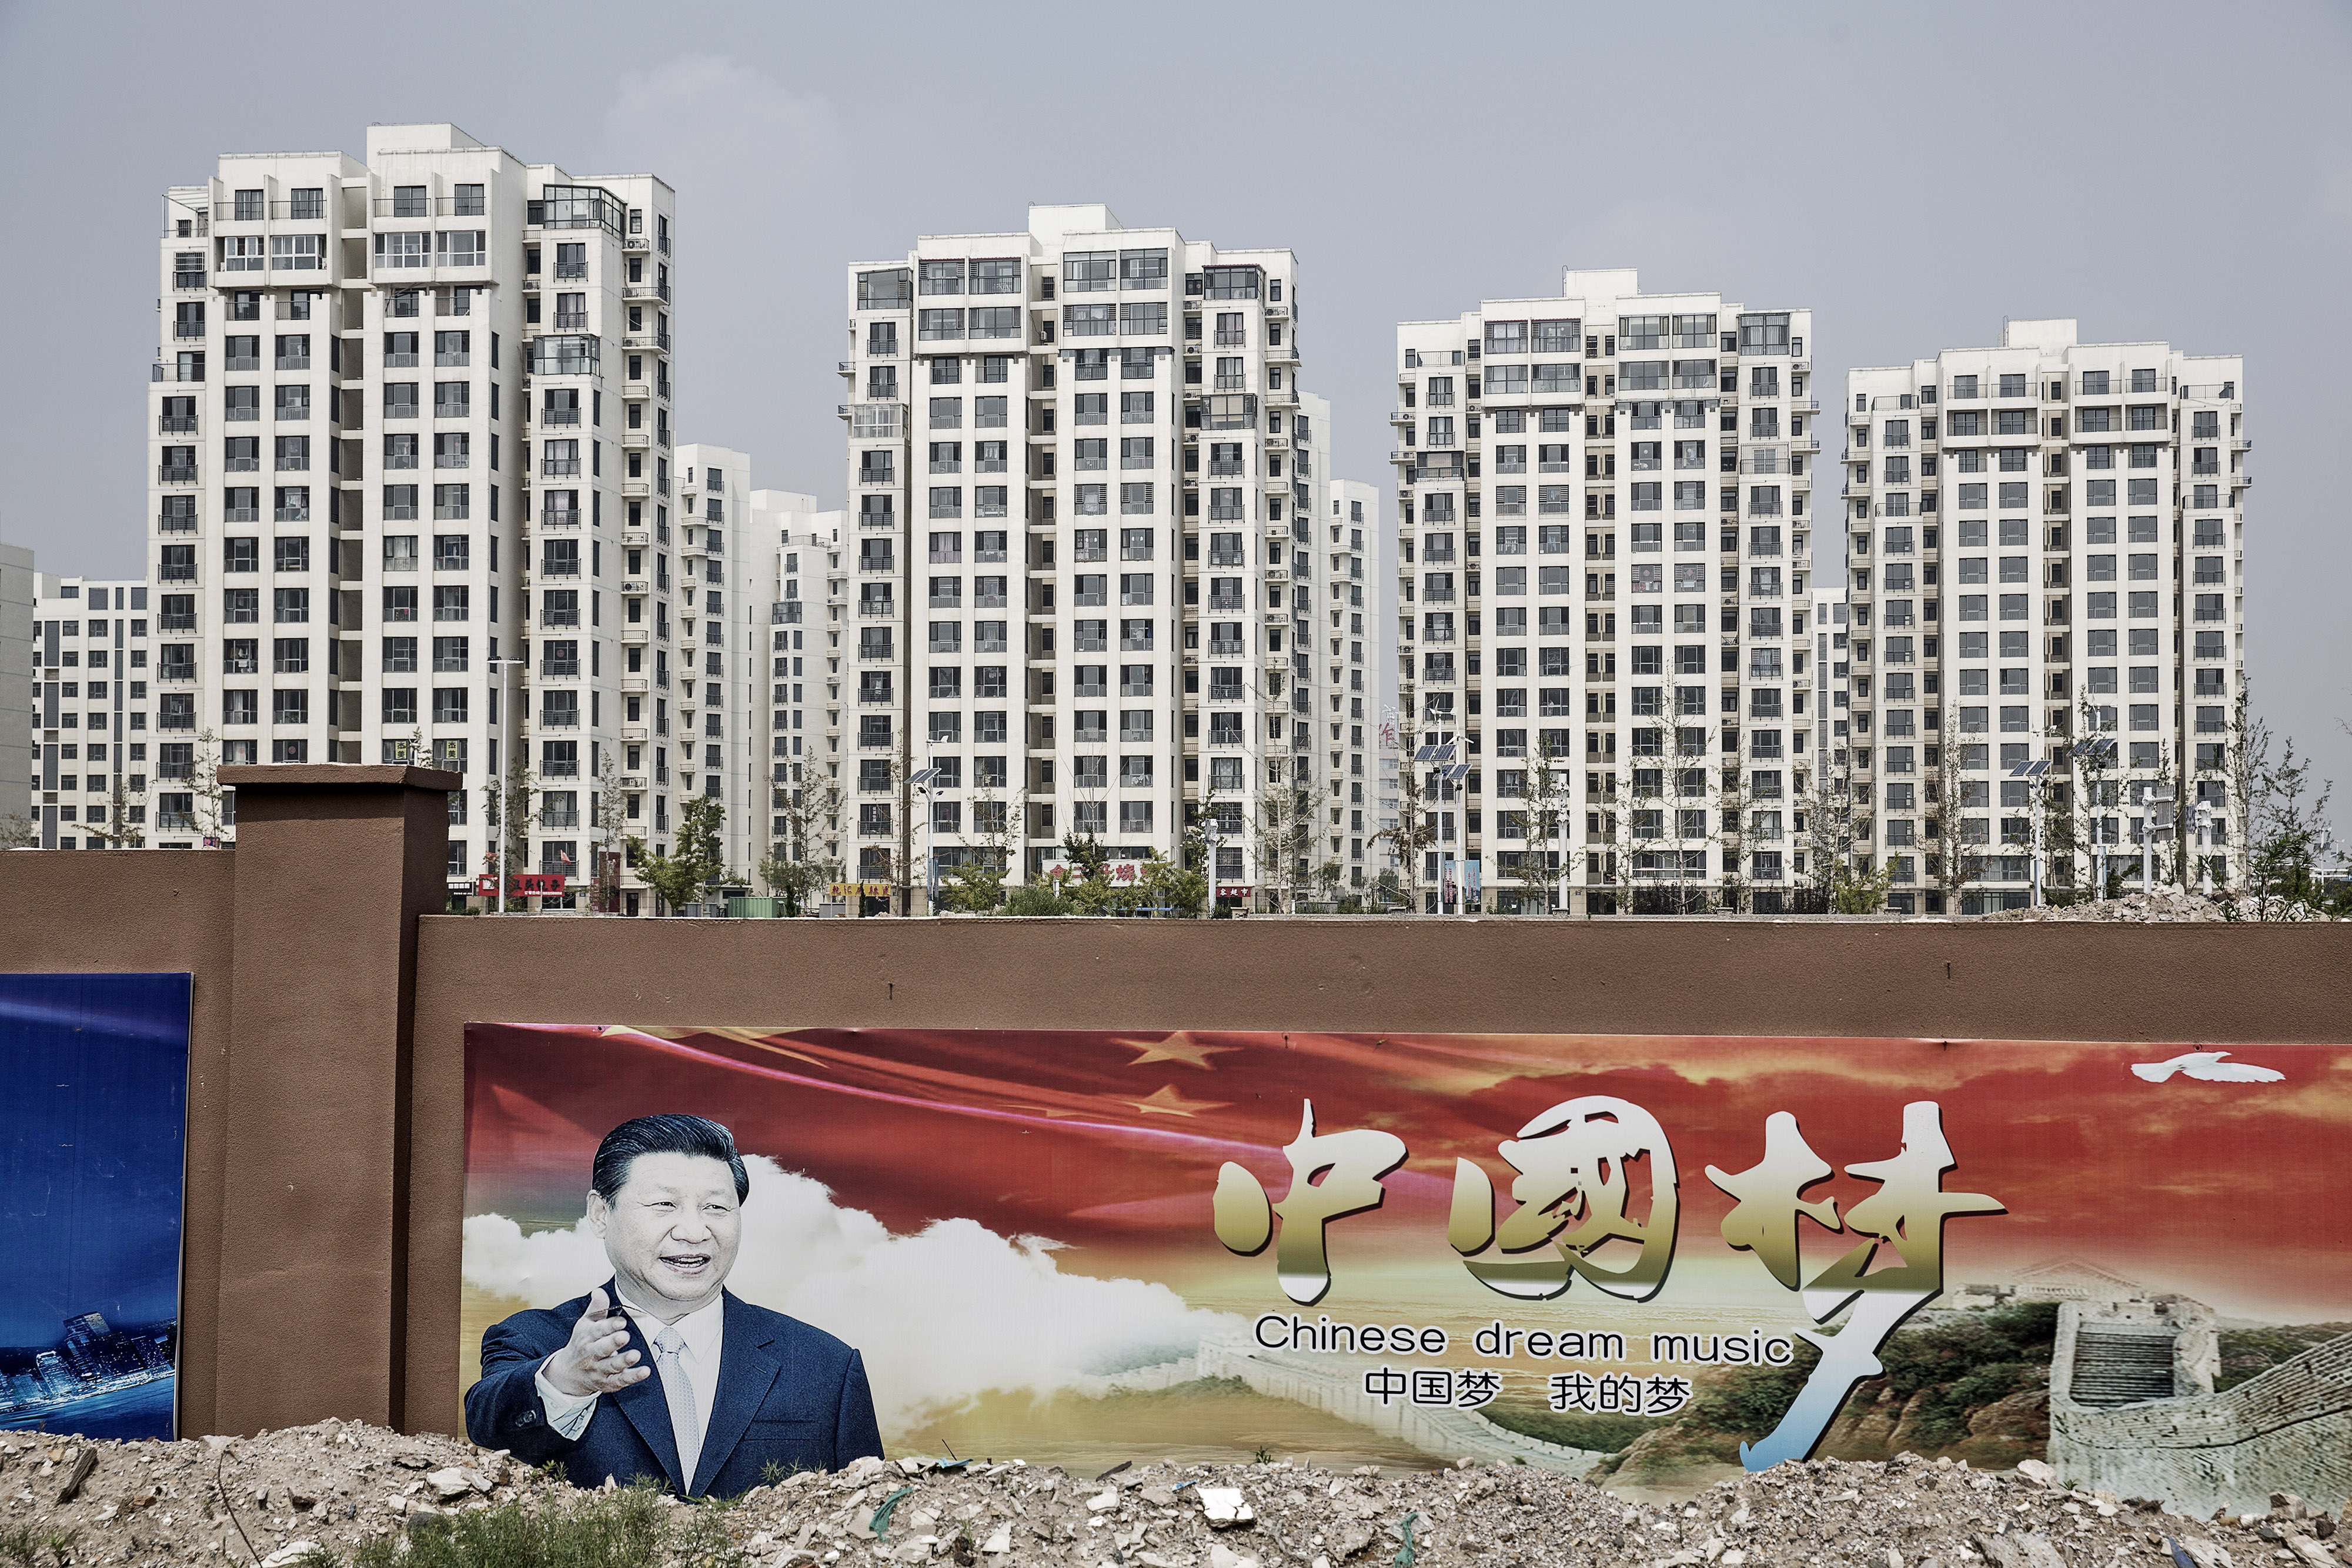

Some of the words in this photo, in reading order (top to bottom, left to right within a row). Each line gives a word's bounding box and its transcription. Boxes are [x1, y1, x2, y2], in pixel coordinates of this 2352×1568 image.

[448, 741, 456, 758] 杰美
[1255, 1315, 1446, 1353] Chinese
[1475, 1322, 1623, 1358] dream
[1653, 1329, 1791, 1363] music
[1365, 1367, 1501, 1407] 中国梦
[1551, 1373, 1690, 1413] 我的梦
